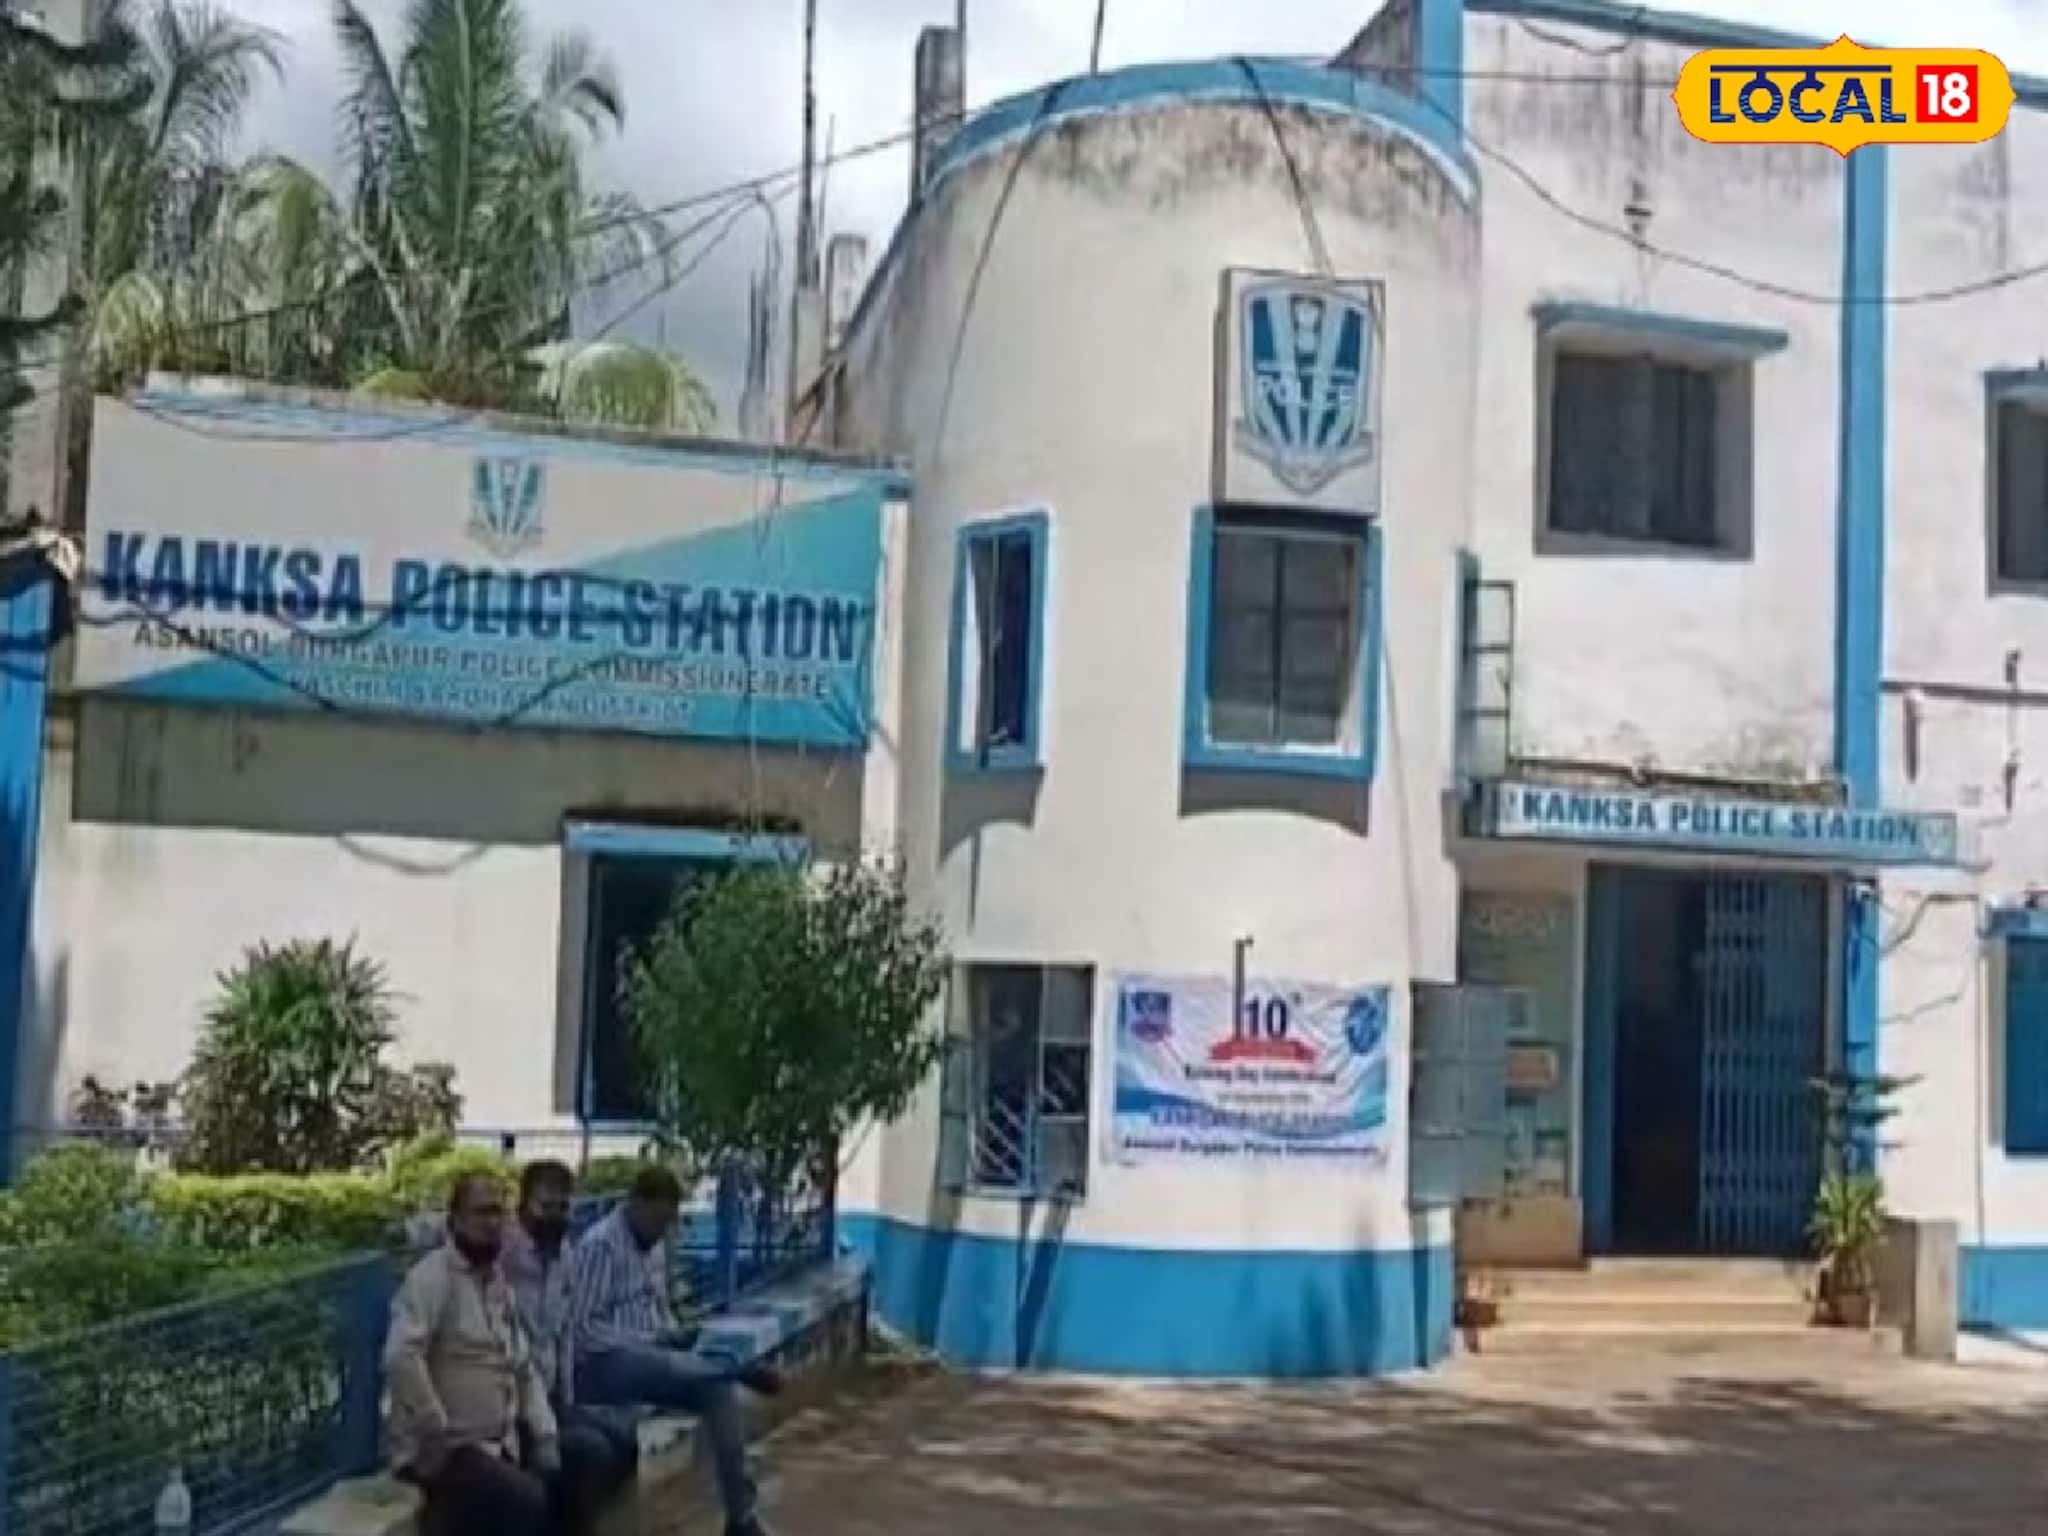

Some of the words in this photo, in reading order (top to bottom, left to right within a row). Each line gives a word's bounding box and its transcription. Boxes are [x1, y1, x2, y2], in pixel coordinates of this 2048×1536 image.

[102, 532, 364, 622] KANKSA
[391, 559, 592, 641] POLICE
[623, 580, 858, 660] STATION
[1523, 791, 1657, 831] KANKSA
[1672, 802, 1773, 835] POLICE
[1791, 812, 1918, 844] STATION
